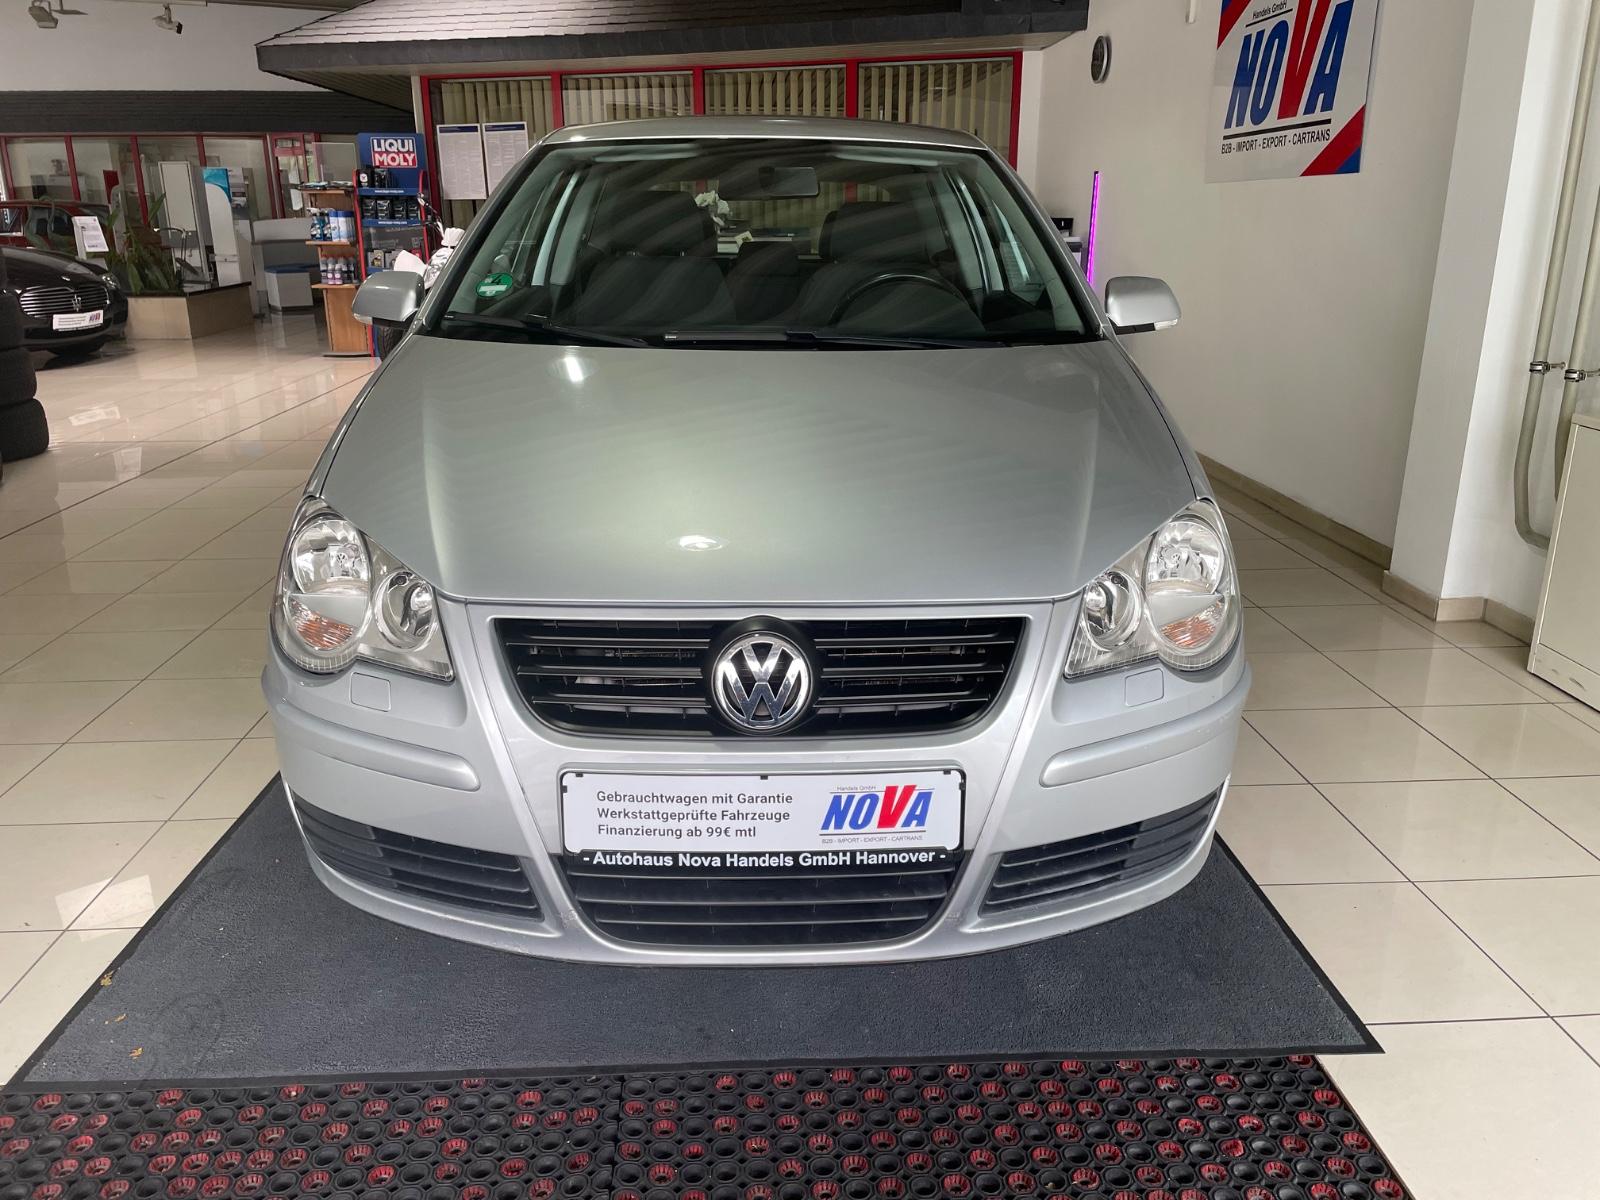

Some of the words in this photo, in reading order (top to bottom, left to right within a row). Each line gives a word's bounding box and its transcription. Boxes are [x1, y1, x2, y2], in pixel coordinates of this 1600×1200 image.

[1253, 7, 1271, 20] Handels
[1272, 0, 1287, 13] GmbH
[1224, 0, 1354, 129] NOVA
[373, 139, 413, 153] LIQUI
[1221, 143, 1232, 154] B2B
[1236, 139, 1258, 152] IMPORT
[1262, 135, 1288, 149] EXPORT
[1292, 128, 1331, 145] CARTRANS
[374, 153, 415, 166] MOLY
[491, 274, 502, 285] 4
[713, 633, 812, 730] VW
[597, 791, 708, 806] Gebrauchtwagen
[712, 793, 733, 804] mit
[737, 793, 793, 804] Garantie
[597, 807, 717, 823] Werkstattgeprüfte
[721, 809, 790, 823] Fahrzeuge
[820, 784, 933, 830] NOVA
[598, 824, 682, 840] Finanzierung
[686, 826, 702, 837] ab
[706, 826, 731, 837] 99€
[735, 826, 756, 837] mtl
[593, 851, 673, 866] Autohaus
[678, 853, 721, 867] Nova
[726, 853, 794, 867] Handels
[799, 852, 850, 866] GmbH
[856, 851, 936, 865] Hannover
